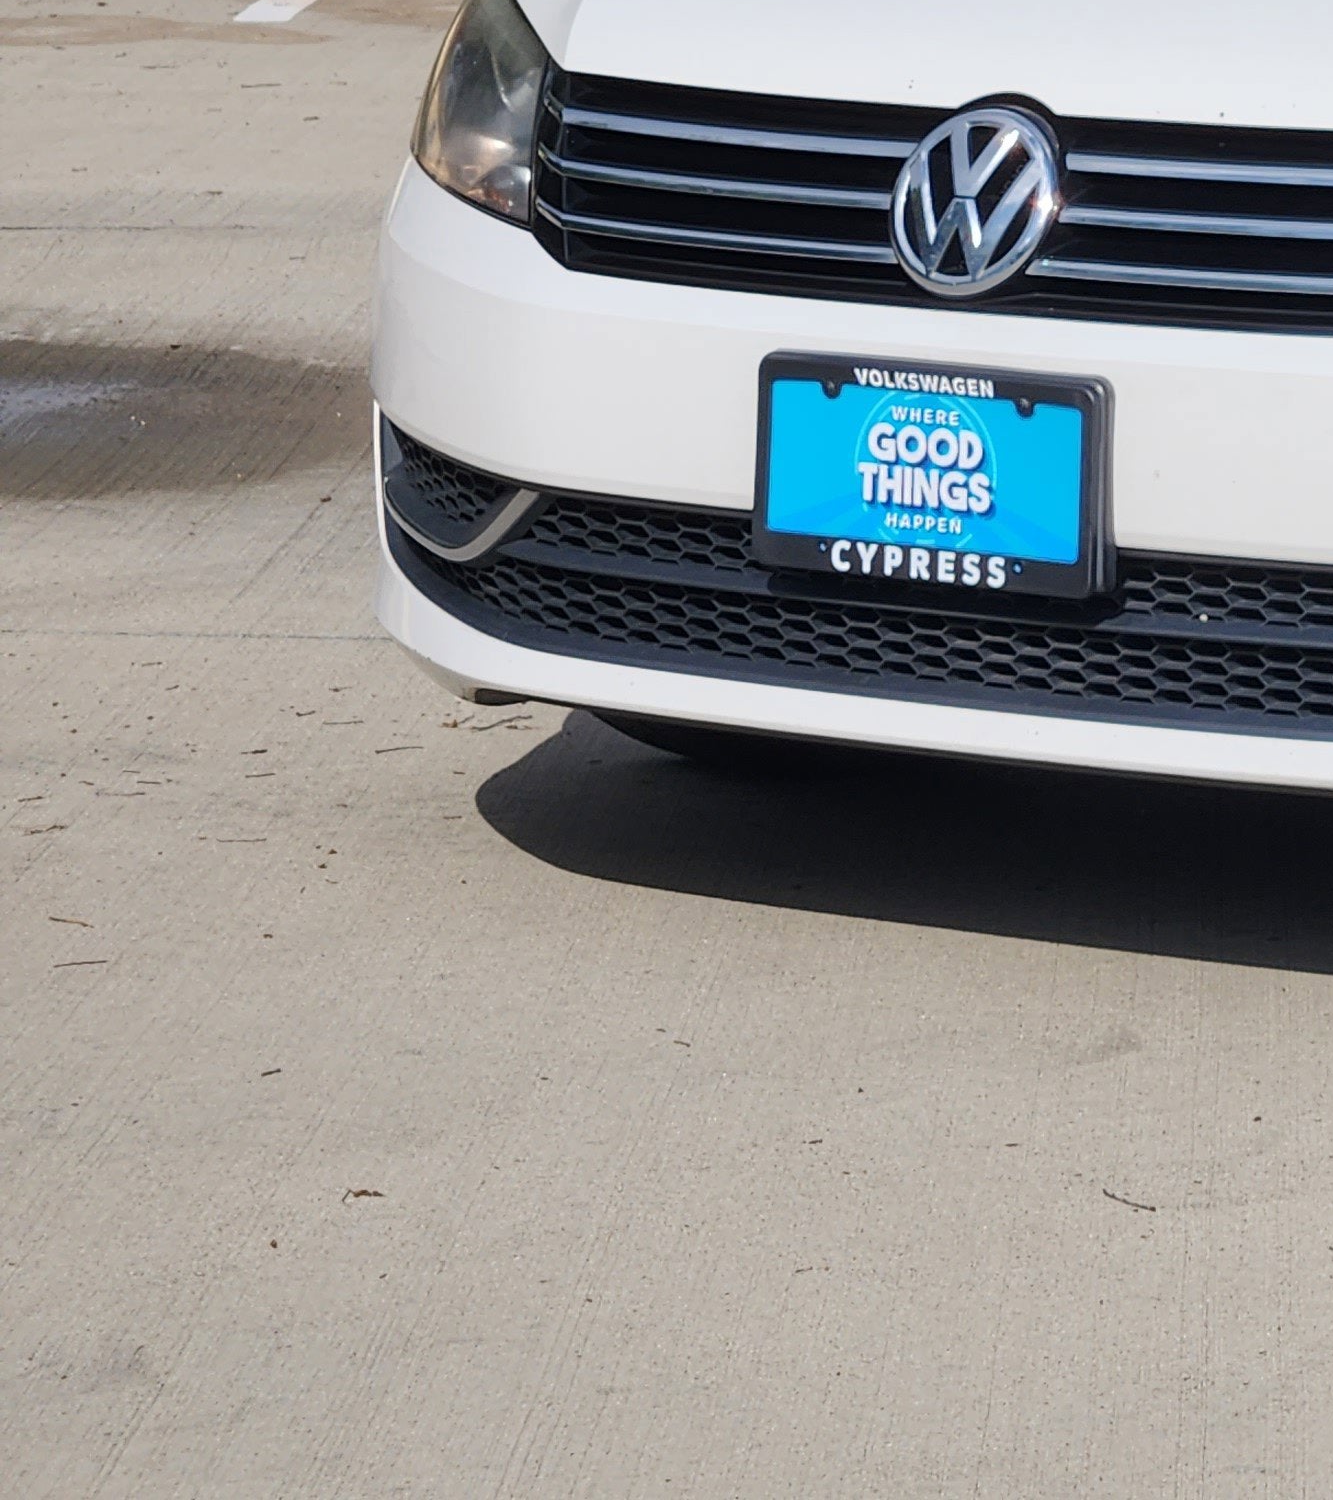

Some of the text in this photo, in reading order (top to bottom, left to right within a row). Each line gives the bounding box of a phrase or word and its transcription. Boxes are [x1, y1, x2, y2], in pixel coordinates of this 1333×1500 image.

[854, 367, 994, 399] VOLKSWAGEN
[891, 405, 960, 426] WHERE
[868, 422, 985, 470] GOOD
[858, 461, 994, 515] THINGS
[884, 512, 962, 535] HAPPEN
[830, 539, 1008, 590] CYPRESS
